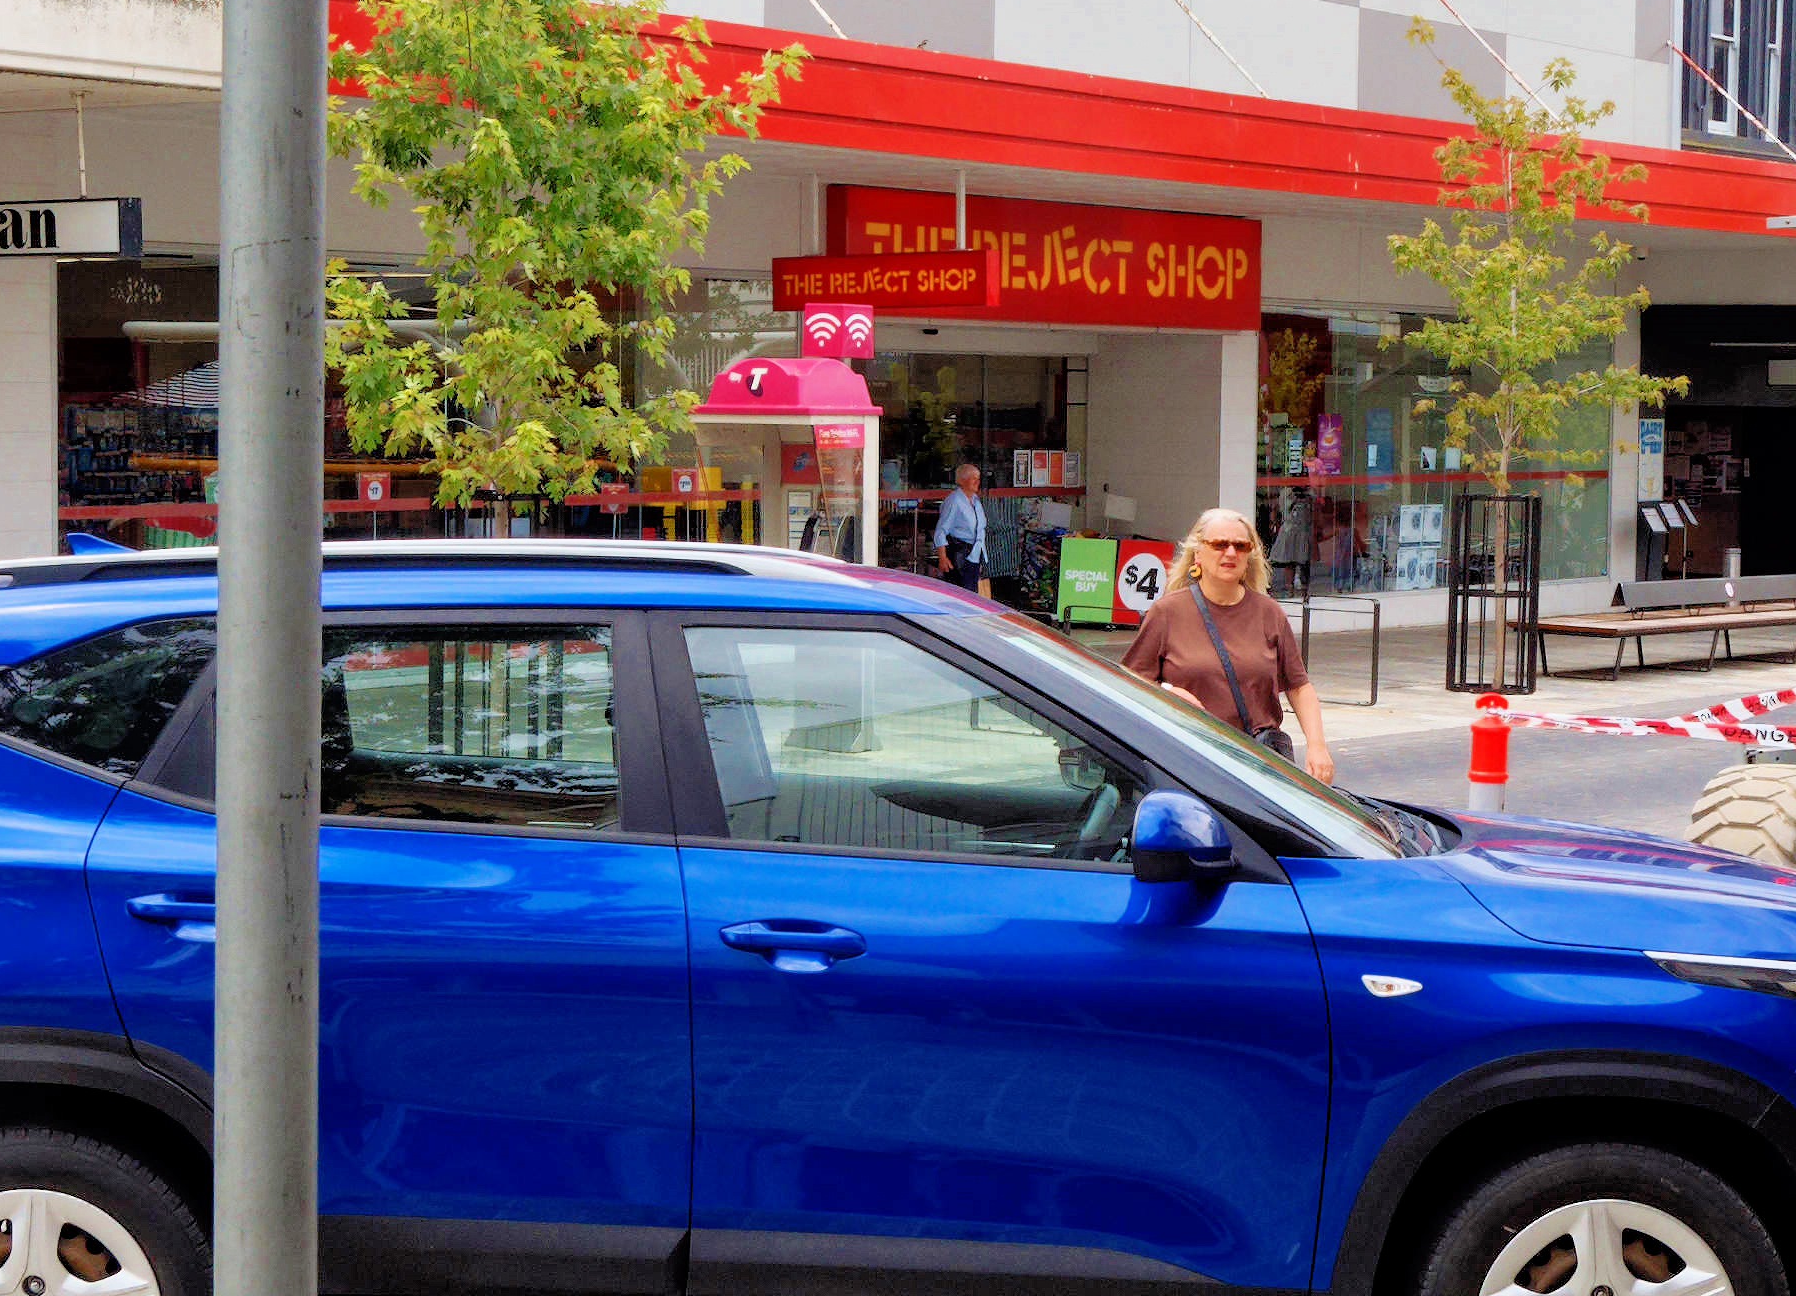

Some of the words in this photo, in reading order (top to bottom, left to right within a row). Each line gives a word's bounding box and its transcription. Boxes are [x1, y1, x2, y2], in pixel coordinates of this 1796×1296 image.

[782, 273, 823, 297] THE
[829, 267, 911, 295] REJECT
[916, 268, 977, 292] SHOP
[1146, 241, 1249, 300] SHOP
[1065, 570, 1110, 582] SPECIAL
[1075, 582, 1098, 593] BUY
[1125, 564, 1160, 600] $4
